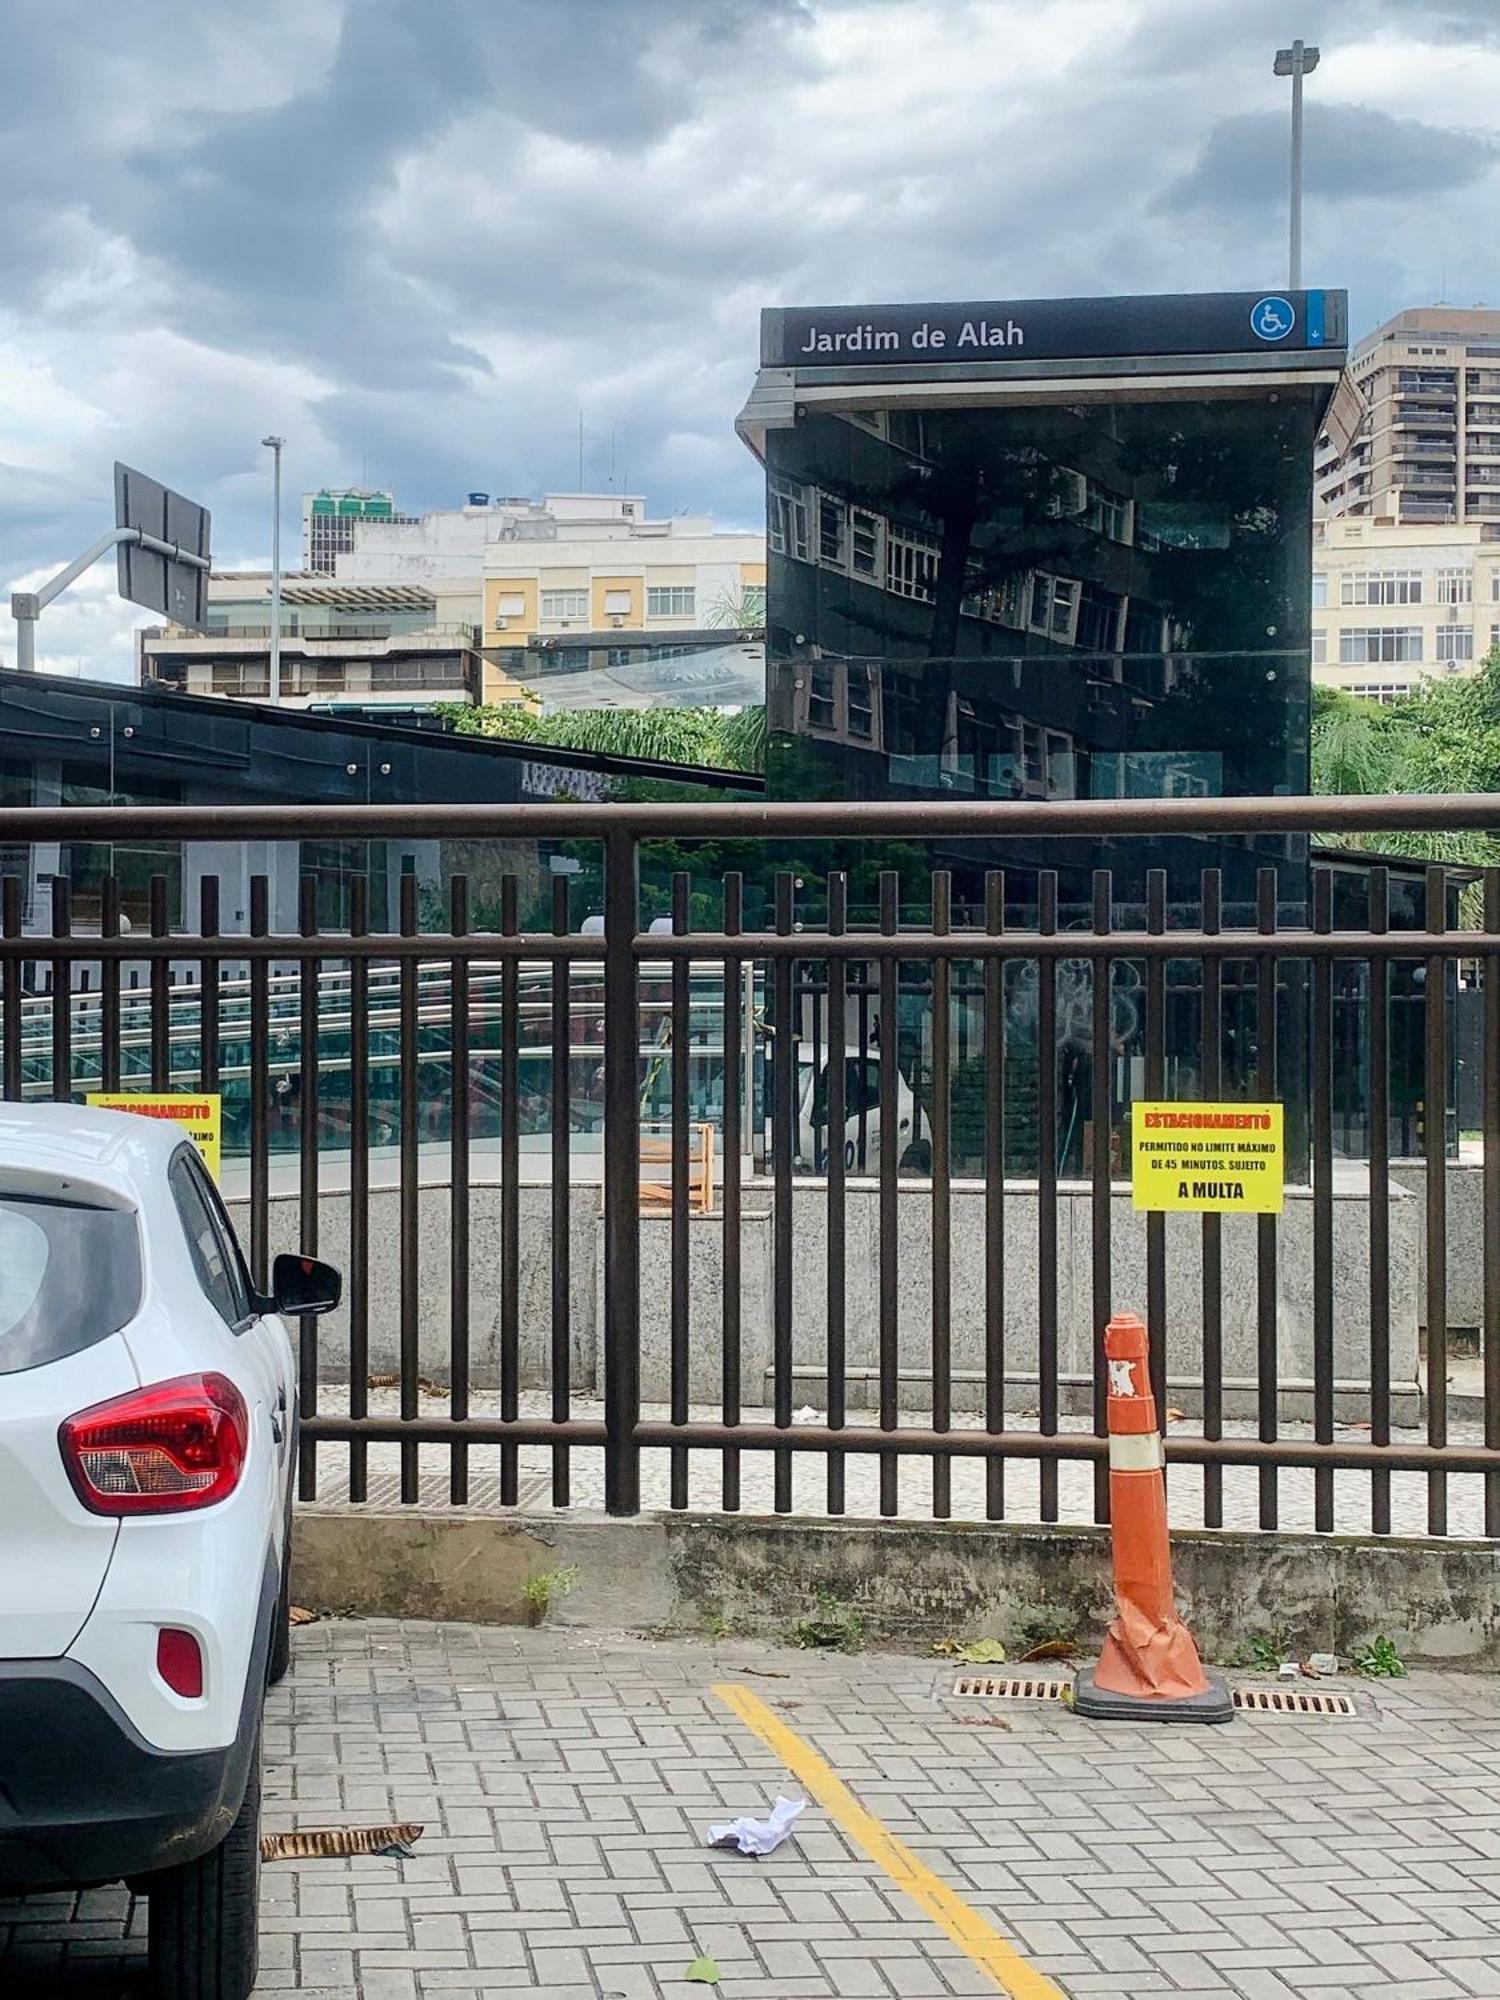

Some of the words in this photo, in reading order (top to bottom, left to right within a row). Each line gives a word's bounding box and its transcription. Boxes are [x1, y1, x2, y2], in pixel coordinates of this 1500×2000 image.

[801, 325, 900, 352] Jardim
[911, 323, 946, 349] de
[957, 320, 1024, 347] Alah
[98, 1104, 210, 1119] CIONAMENTO
[1144, 1112, 1271, 1130] ESTACIONAMENTO
[1139, 1141, 1189, 1152] PERMITIDO
[1191, 1142, 1204, 1152] NO
[1205, 1142, 1235, 1153] LIMITE
[1237, 1141, 1276, 1153] MÁXIMO
[1151, 1159, 1163, 1169] DE
[1164, 1159, 1177, 1169] 45
[1229, 1160, 1266, 1171] SUJEITO
[1178, 1182, 1188, 1198] A
[1192, 1182, 1244, 1199] MULTA
